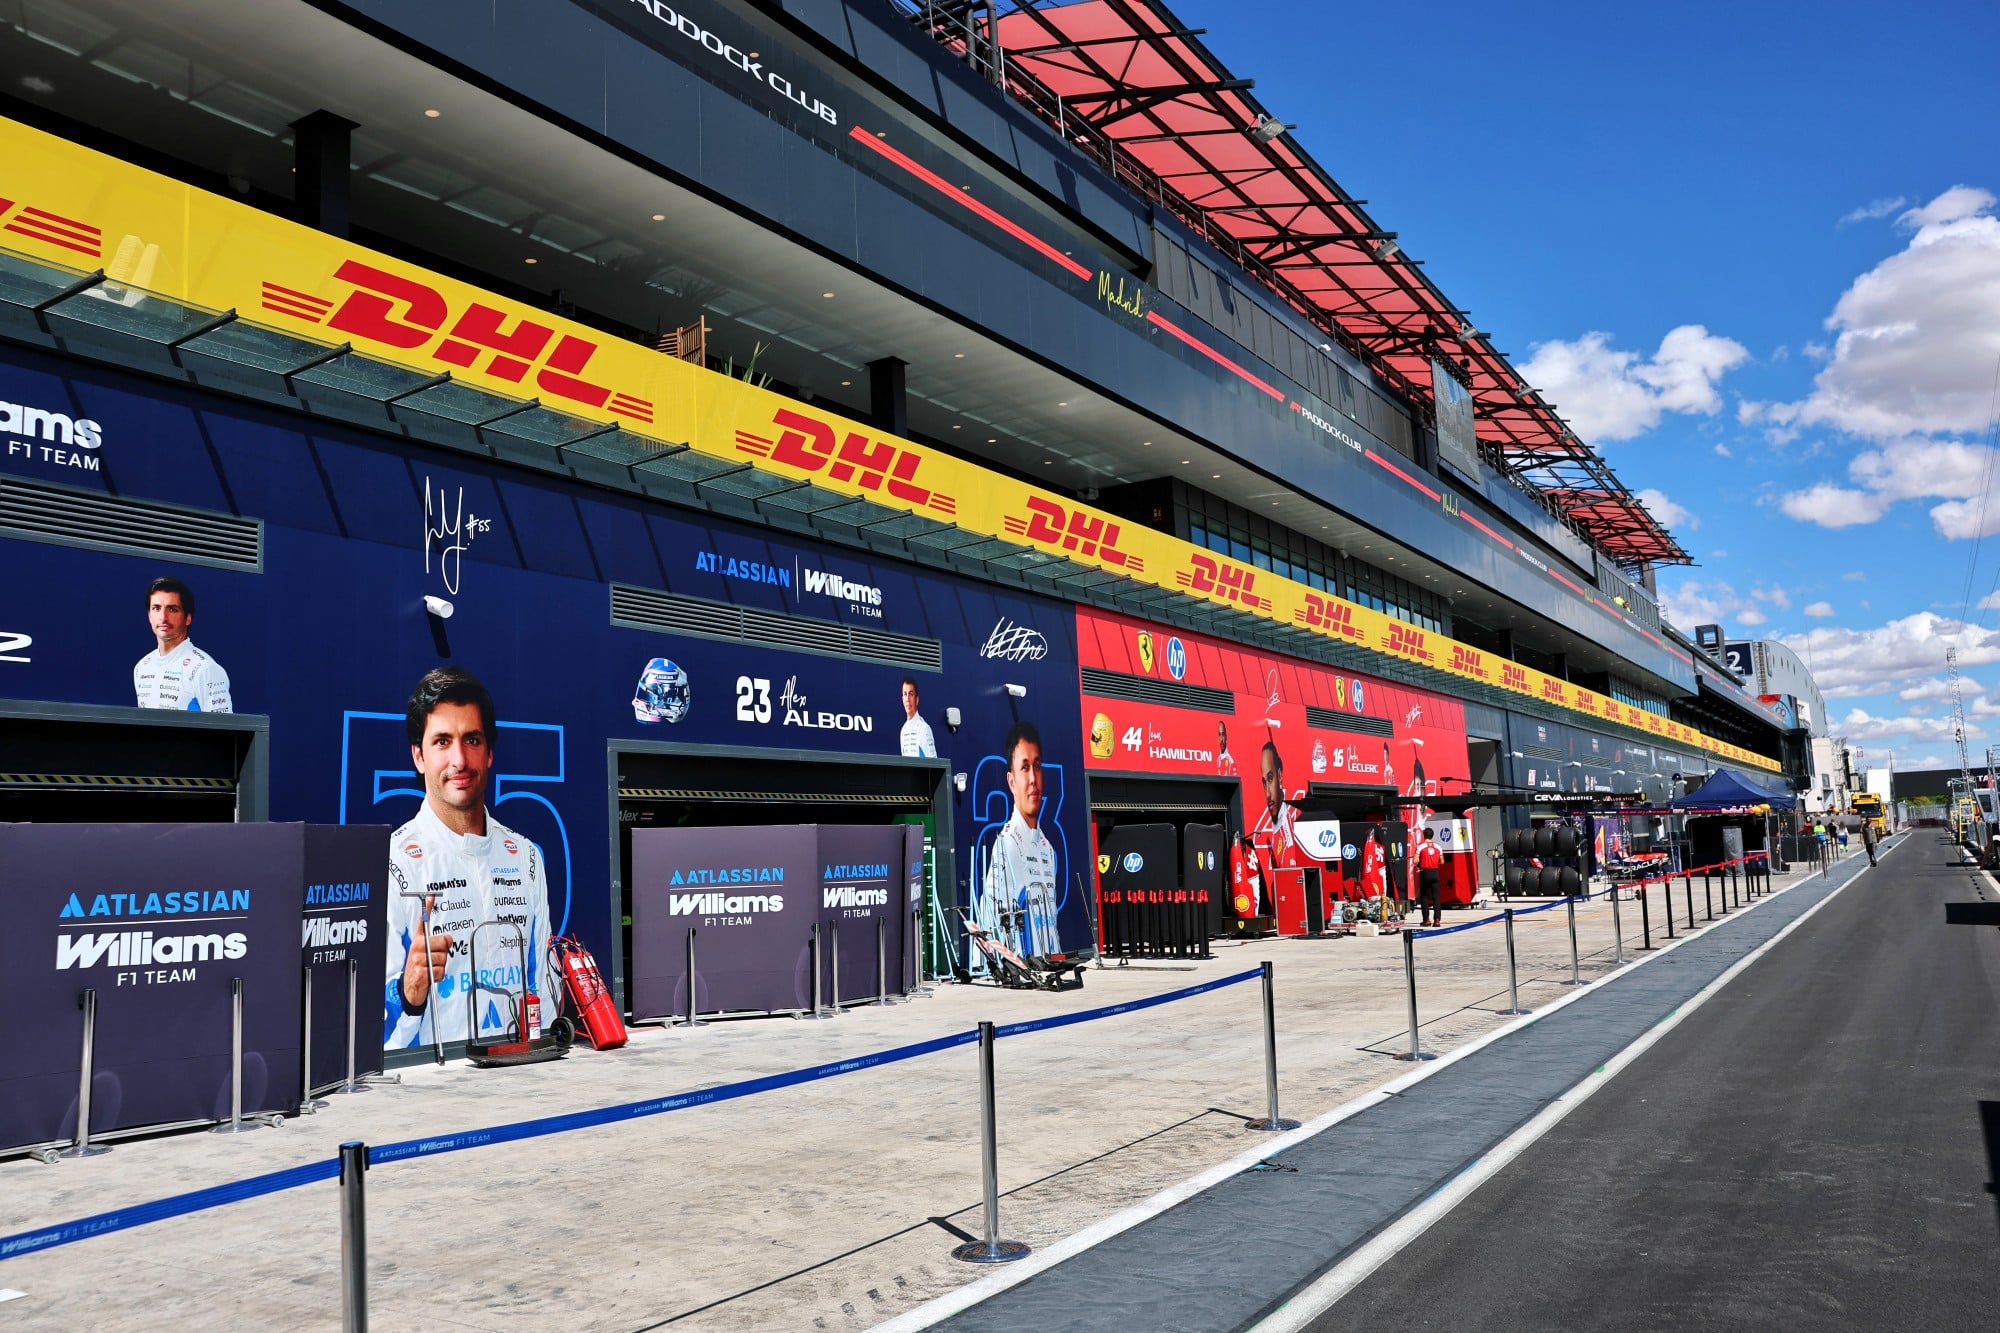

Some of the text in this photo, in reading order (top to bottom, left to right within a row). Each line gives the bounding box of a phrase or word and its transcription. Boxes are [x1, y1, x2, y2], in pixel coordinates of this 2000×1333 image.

[768, 72, 837, 126] CLUB
[1098, 270, 1144, 318] Madrid
[328, 259, 612, 408] DHL
[1302, 407, 1362, 452] PADDOCK CLUB
[9, 440, 100, 471] F1 TEAM
[770, 408, 931, 505] DHL
[1026, 495, 1127, 566] DHL
[696, 550, 882, 606] ATLASSIAN Williams
[1190, 553, 1260, 608] DHL
[851, 603, 882, 618] F1 TEAM
[1305, 593, 1356, 637] DHL
[1389, 623, 1428, 659] DHL
[1169, 638, 1184, 679] hp
[1453, 645, 1484, 677] DHL
[1727, 651, 1743, 671] 2
[1502, 663, 1528, 690] DHL
[736, 674, 807, 724] 23 Alex
[783, 709, 873, 732] ALBON
[1121, 726, 1143, 751] 44
[1149, 746, 1213, 762] HAMILTON
[1333, 748, 1344, 767] 16
[1348, 762, 1379, 773] LECLERC
[1321, 830, 1334, 847] hp
[1441, 828, 1451, 842] hp
[1126, 852, 1142, 872] hp
[1344, 844, 1355, 859] hp
[493, 877, 522, 887] Williams
[687, 867, 784, 884] ATLASSIAN
[834, 863, 888, 879] ATLASSIAN
[306, 882, 370, 905] ATLASSIAN
[427, 877, 467, 891] KOMATSU
[89, 889, 250, 917] ATLASSIAN
[440, 899, 471, 912] Claude
[494, 897, 527, 906] DURACELL
[669, 892, 784, 916] Williams
[823, 887, 887, 908] Williams
[704, 916, 752, 926] F1 TEAM
[843, 908, 871, 918] F1 TEAM
[56, 931, 248, 970] Williams
[313, 949, 346, 964] F1 TEAM
[117, 968, 197, 986] F1 TEAM
[662, 1098, 688, 1109] Williams
[697, 1093, 714, 1101] TEAM
[419, 1140, 454, 1152] Williams
[456, 1138, 465, 1146] F1
[468, 1134, 491, 1143] TEAM
[1, 1218, 120, 1254] Williams F1 TEAM
